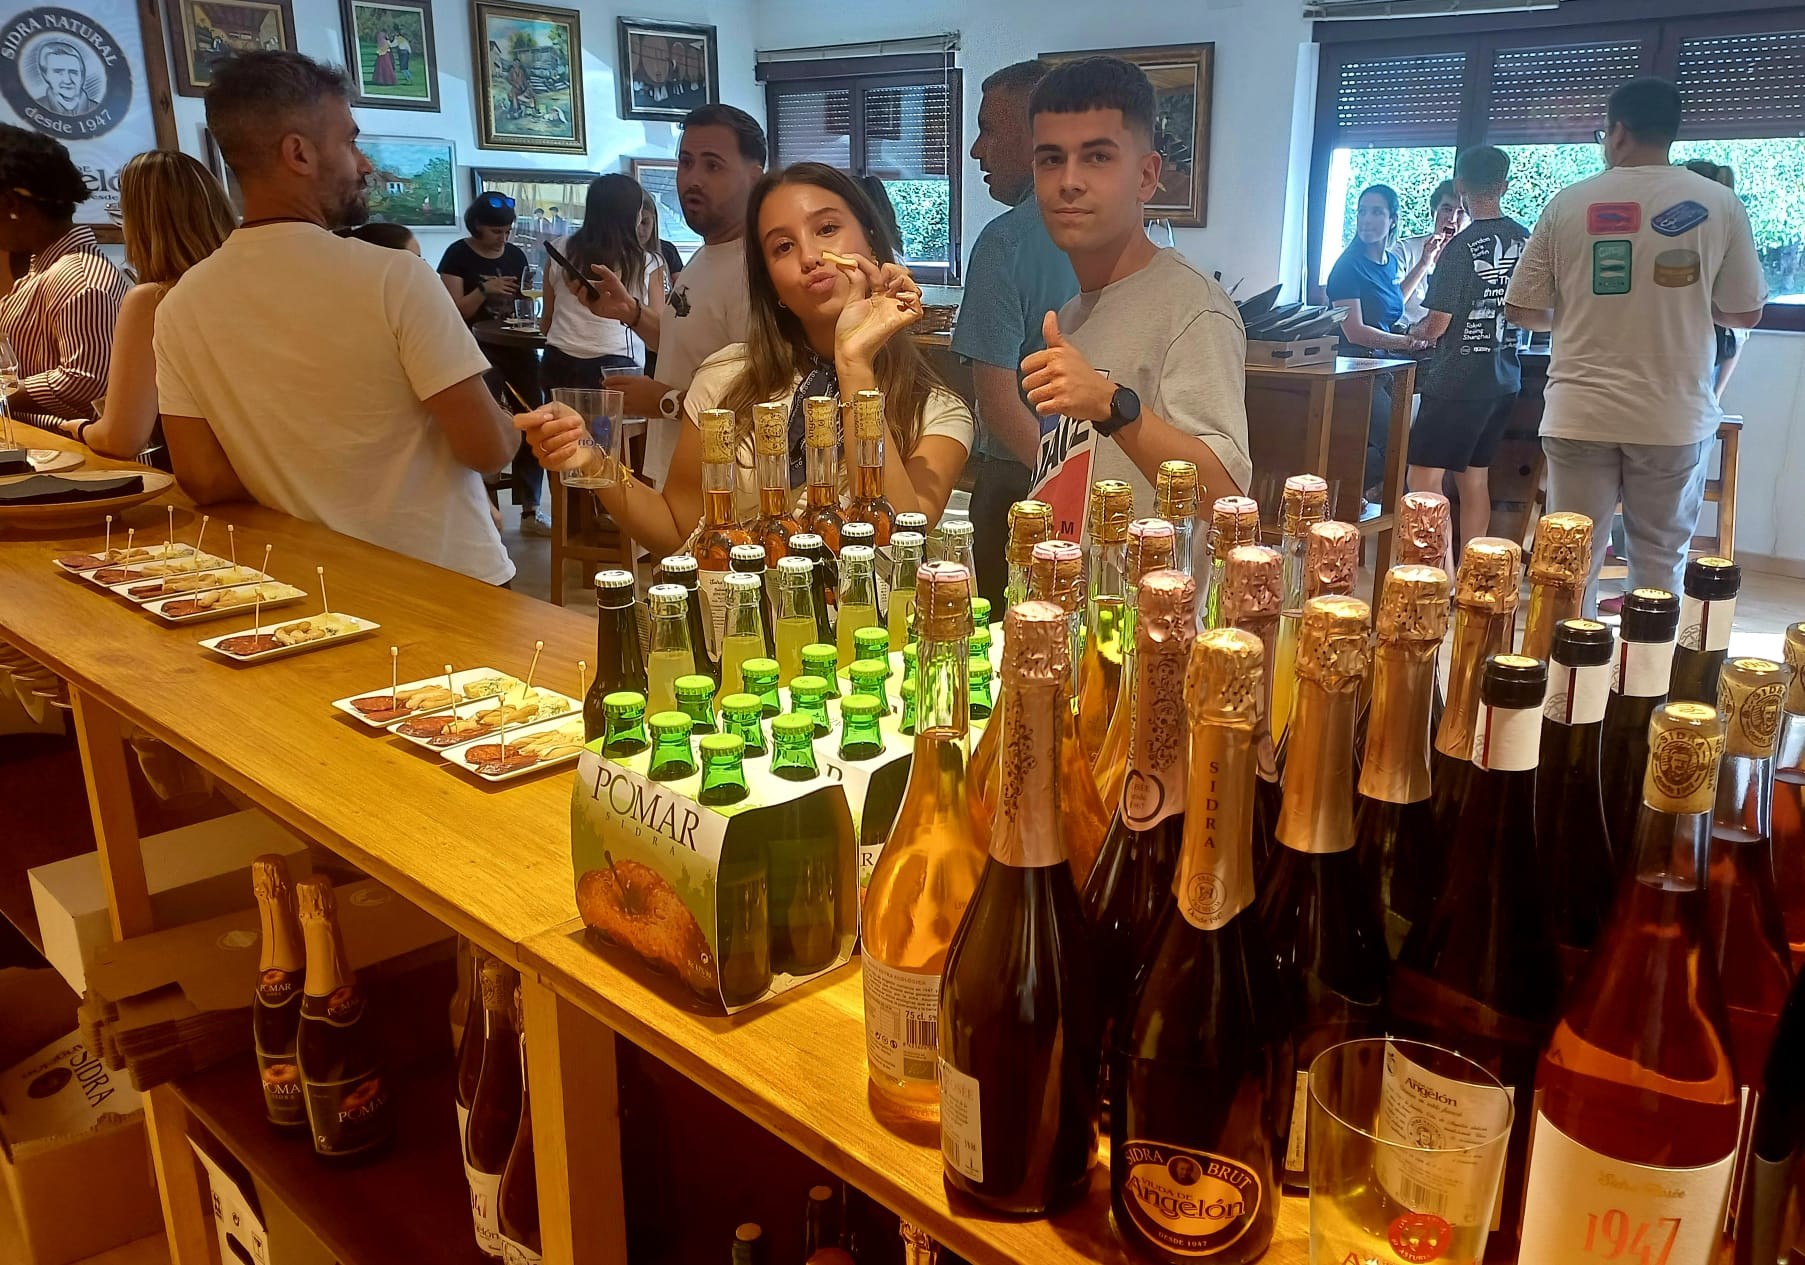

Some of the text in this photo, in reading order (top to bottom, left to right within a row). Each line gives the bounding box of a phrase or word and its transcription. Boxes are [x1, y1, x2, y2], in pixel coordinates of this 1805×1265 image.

[1, 14, 119, 67] SIDRA NATURAL
[25, 105, 112, 134] desde 1947
[1660, 731, 1705, 751] SIDRA
[591, 765, 700, 852] POMAR
[1203, 761, 1220, 849] SIDRA
[604, 811, 677, 857] SIDRA
[259, 983, 291, 993] POMAR
[905, 1010, 915, 1019] 75
[69, 1050, 115, 1108] SIDRA
[262, 1079, 301, 1095] POMA
[1405, 1077, 1458, 1107] Angelón
[1125, 1147, 1252, 1189] SIDRA BRUT
[1125, 1174, 1246, 1219] Angelón
[1157, 1231, 1184, 1247] DESDE
[1584, 1208, 1682, 1265] 1947
